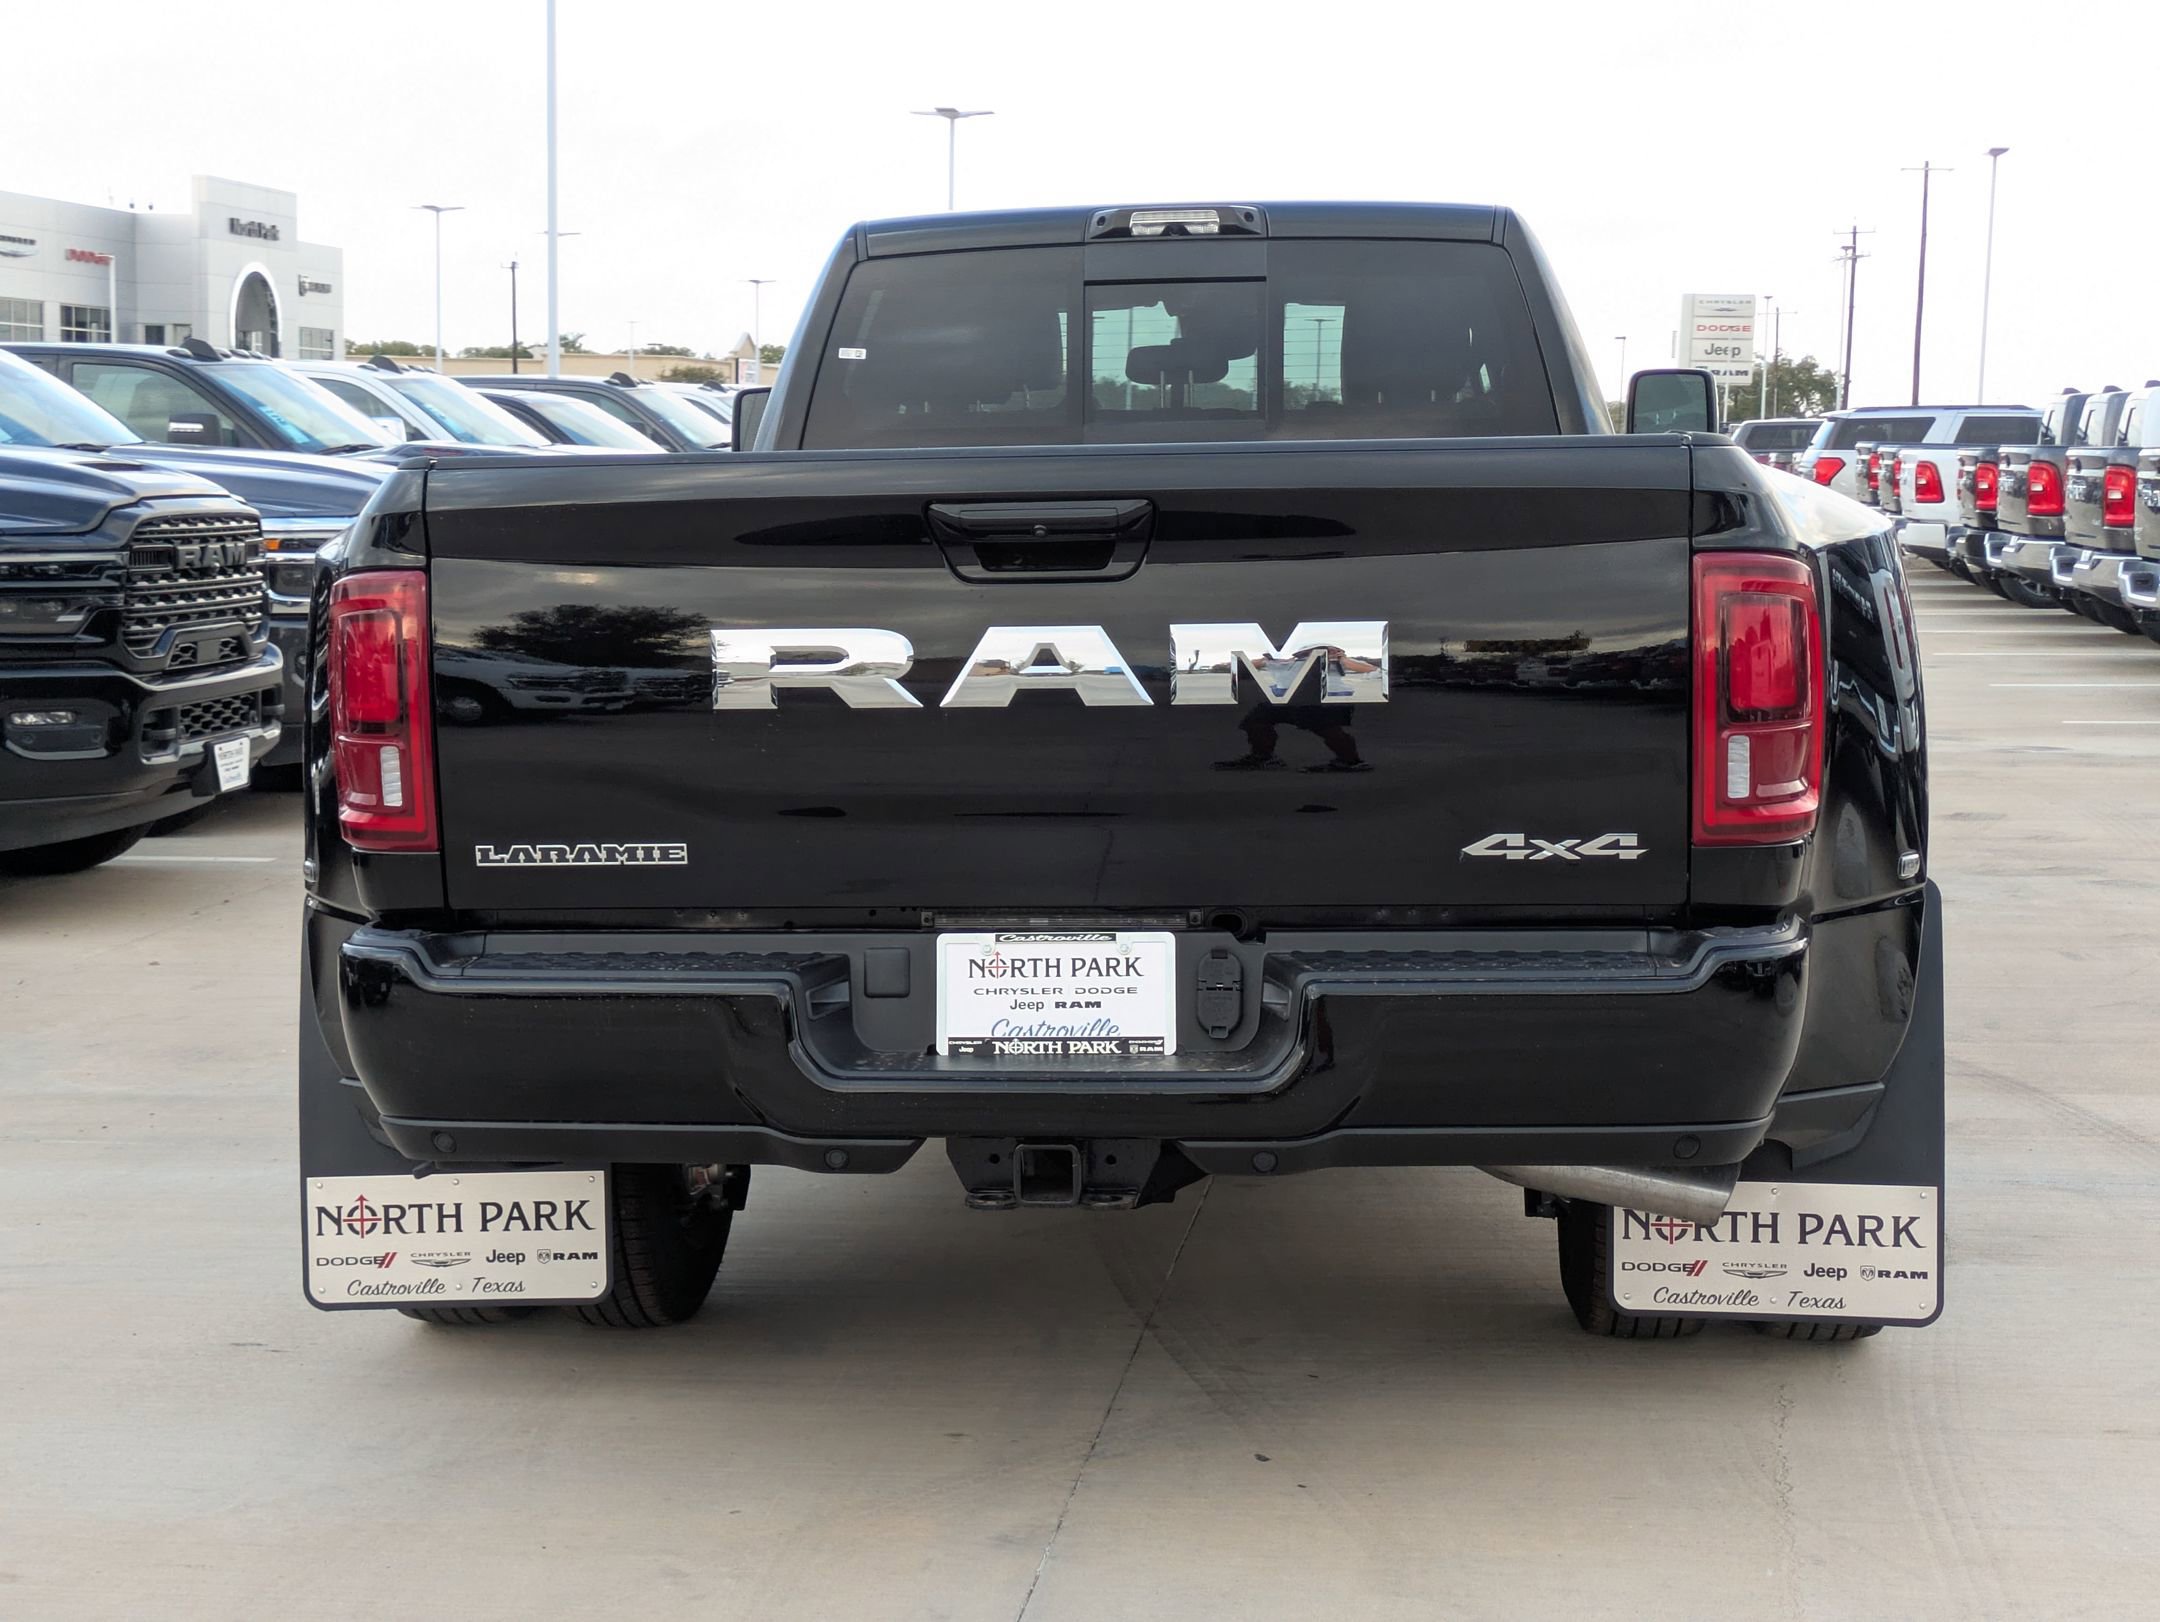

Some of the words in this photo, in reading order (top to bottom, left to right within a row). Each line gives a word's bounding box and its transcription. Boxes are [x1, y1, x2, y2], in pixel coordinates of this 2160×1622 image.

[1696, 324, 1752, 332] DODGE
[1704, 343, 1741, 358] Jeep
[177, 542, 246, 570] RAM
[710, 620, 1389, 709] RAM
[475, 843, 688, 867] LARAMIE
[968, 956, 1061, 979] NORTH
[1071, 957, 1144, 977] PARK
[973, 987, 1063, 995] CHRYSLER
[1075, 986, 1138, 995] DODGE
[1010, 999, 1045, 1012] Jeep
[1054, 1001, 1102, 1009] RAM
[991, 1018, 1121, 1037] Castroville
[992, 1039, 1061, 1055] NORTH
[1066, 1040, 1122, 1054] PARK
[315, 1202, 463, 1236] NORTH
[479, 1199, 597, 1232] PARK
[1797, 1212, 1927, 1248] PARK
[316, 1255, 386, 1267] DODGE
[486, 1249, 526, 1265] Jeep
[552, 1251, 598, 1261] RAM
[1621, 1261, 1695, 1273] DODGE
[1803, 1263, 1847, 1281] Jeep
[1877, 1269, 1928, 1280] RAM
[347, 1278, 447, 1296] Castroville
[472, 1277, 526, 1293] Texas
[1653, 1286, 1760, 1307] Castroville
[1787, 1290, 1847, 1309] Texas
